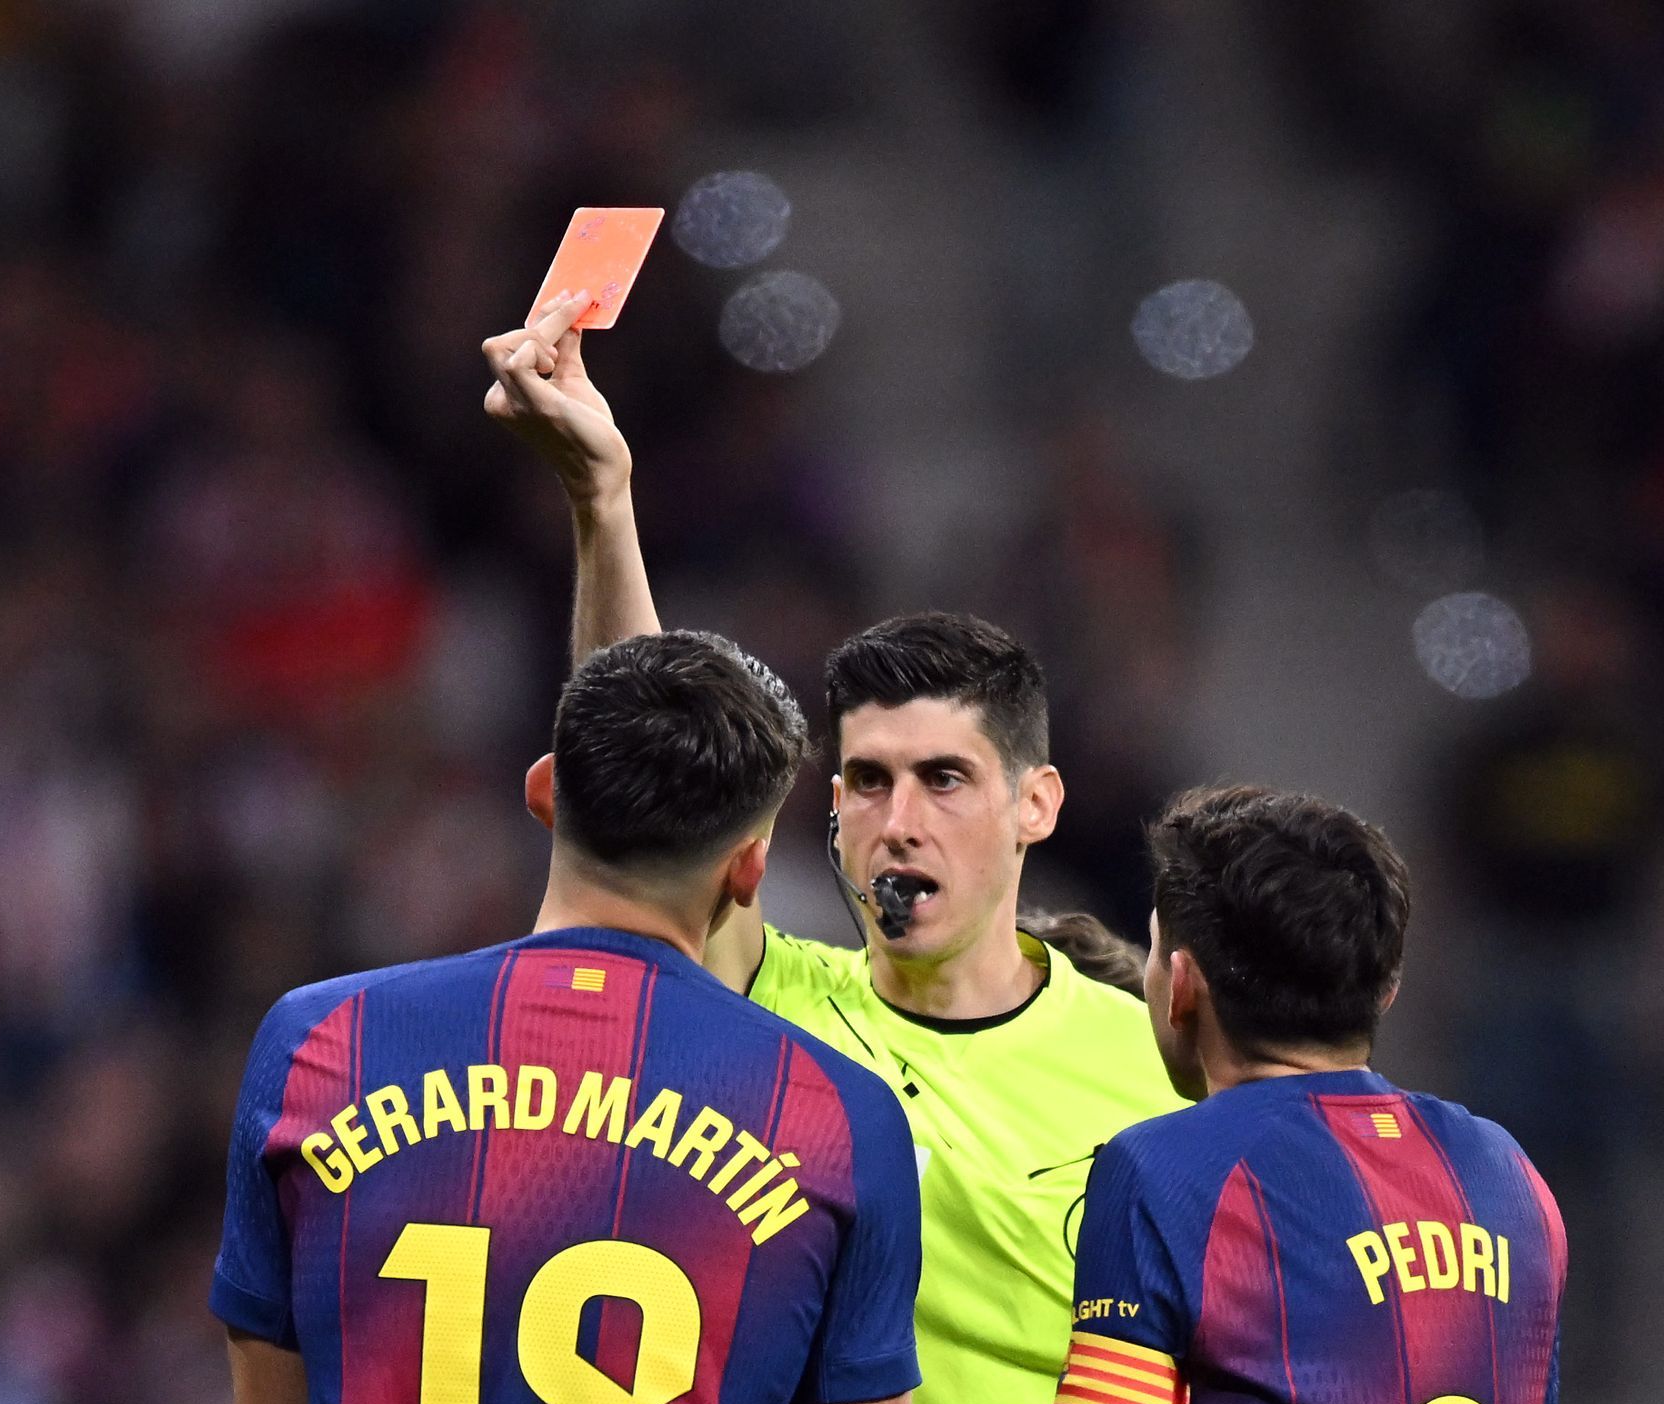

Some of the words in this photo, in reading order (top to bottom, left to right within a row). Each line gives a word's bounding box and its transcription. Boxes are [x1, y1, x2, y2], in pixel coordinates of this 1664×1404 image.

[300, 1063, 558, 1194] GERARD
[562, 1070, 811, 1247] MARTÍN
[1346, 1220, 1511, 1306] PEDRI
[1117, 1300, 1140, 1318] tv
